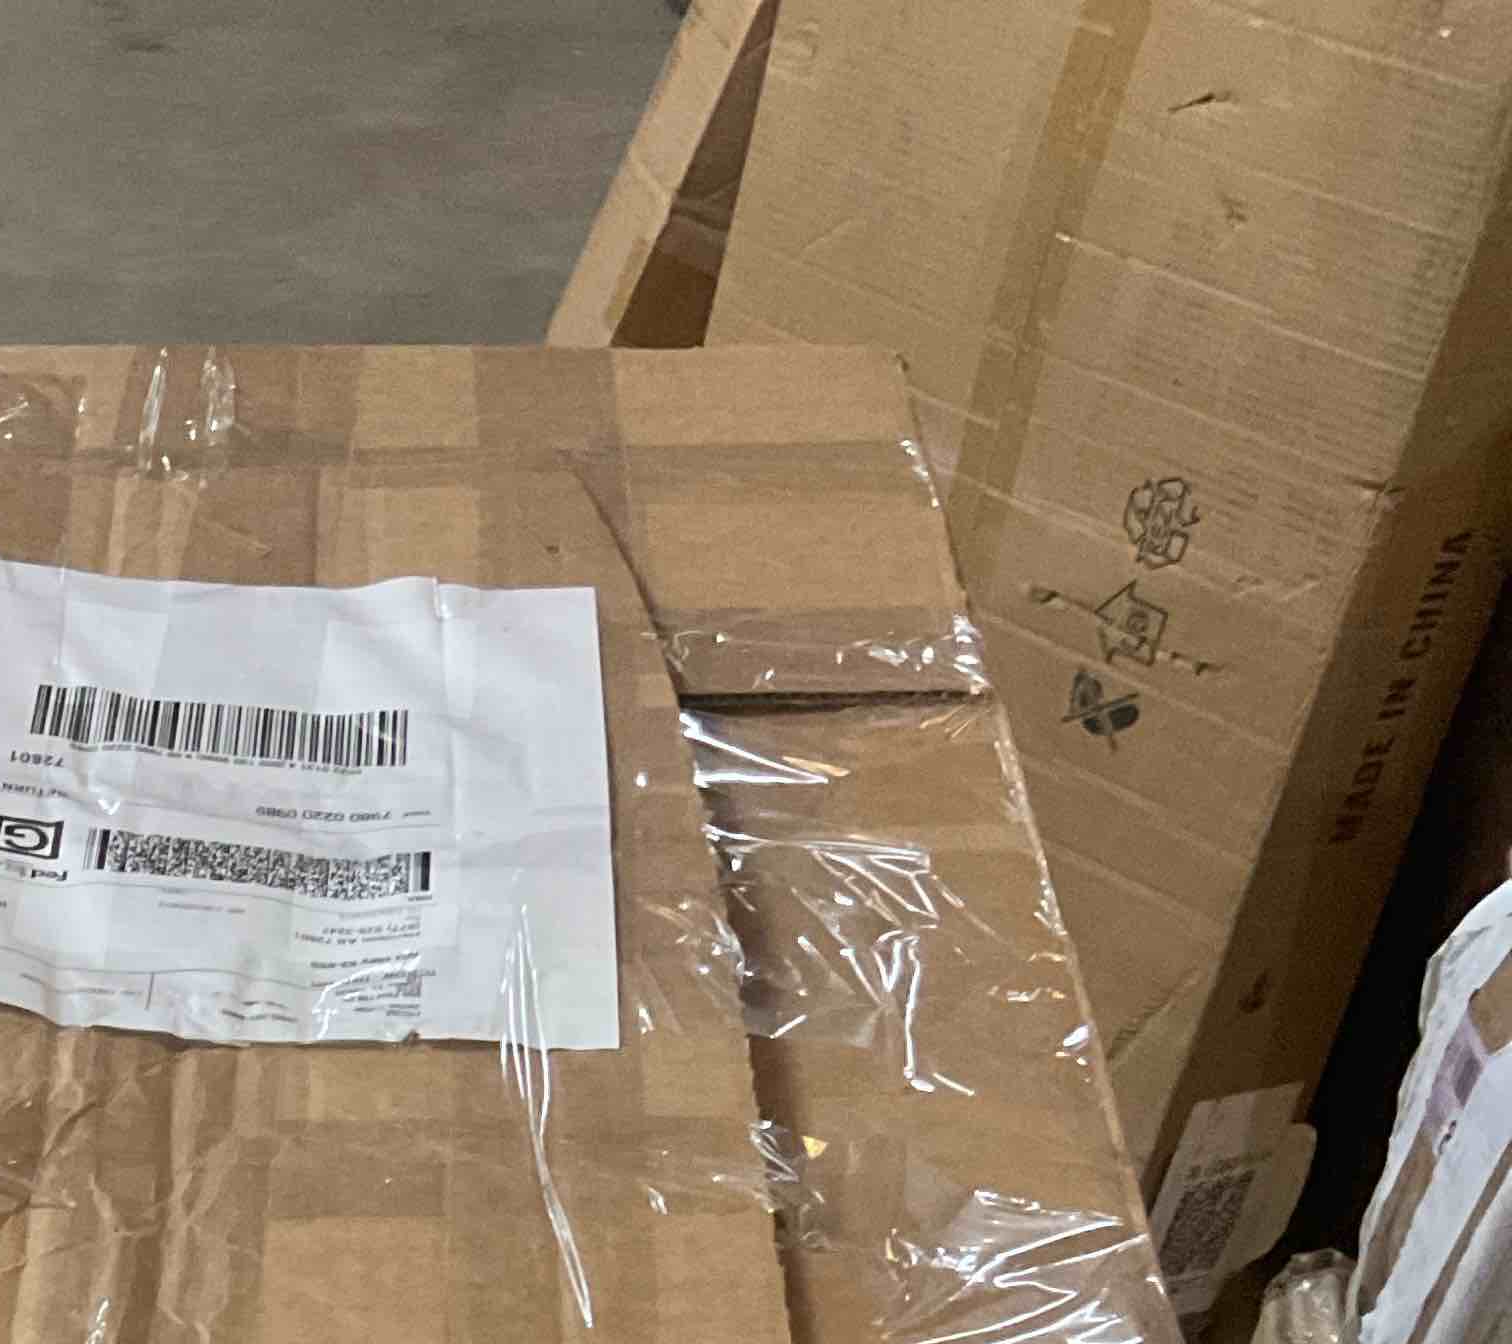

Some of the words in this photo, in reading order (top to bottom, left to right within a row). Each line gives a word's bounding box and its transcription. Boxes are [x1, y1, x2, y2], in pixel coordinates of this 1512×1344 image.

[1329, 738, 1395, 843] MADE
[1378, 678, 1417, 720] IN
[1399, 529, 1471, 659] CHINA
